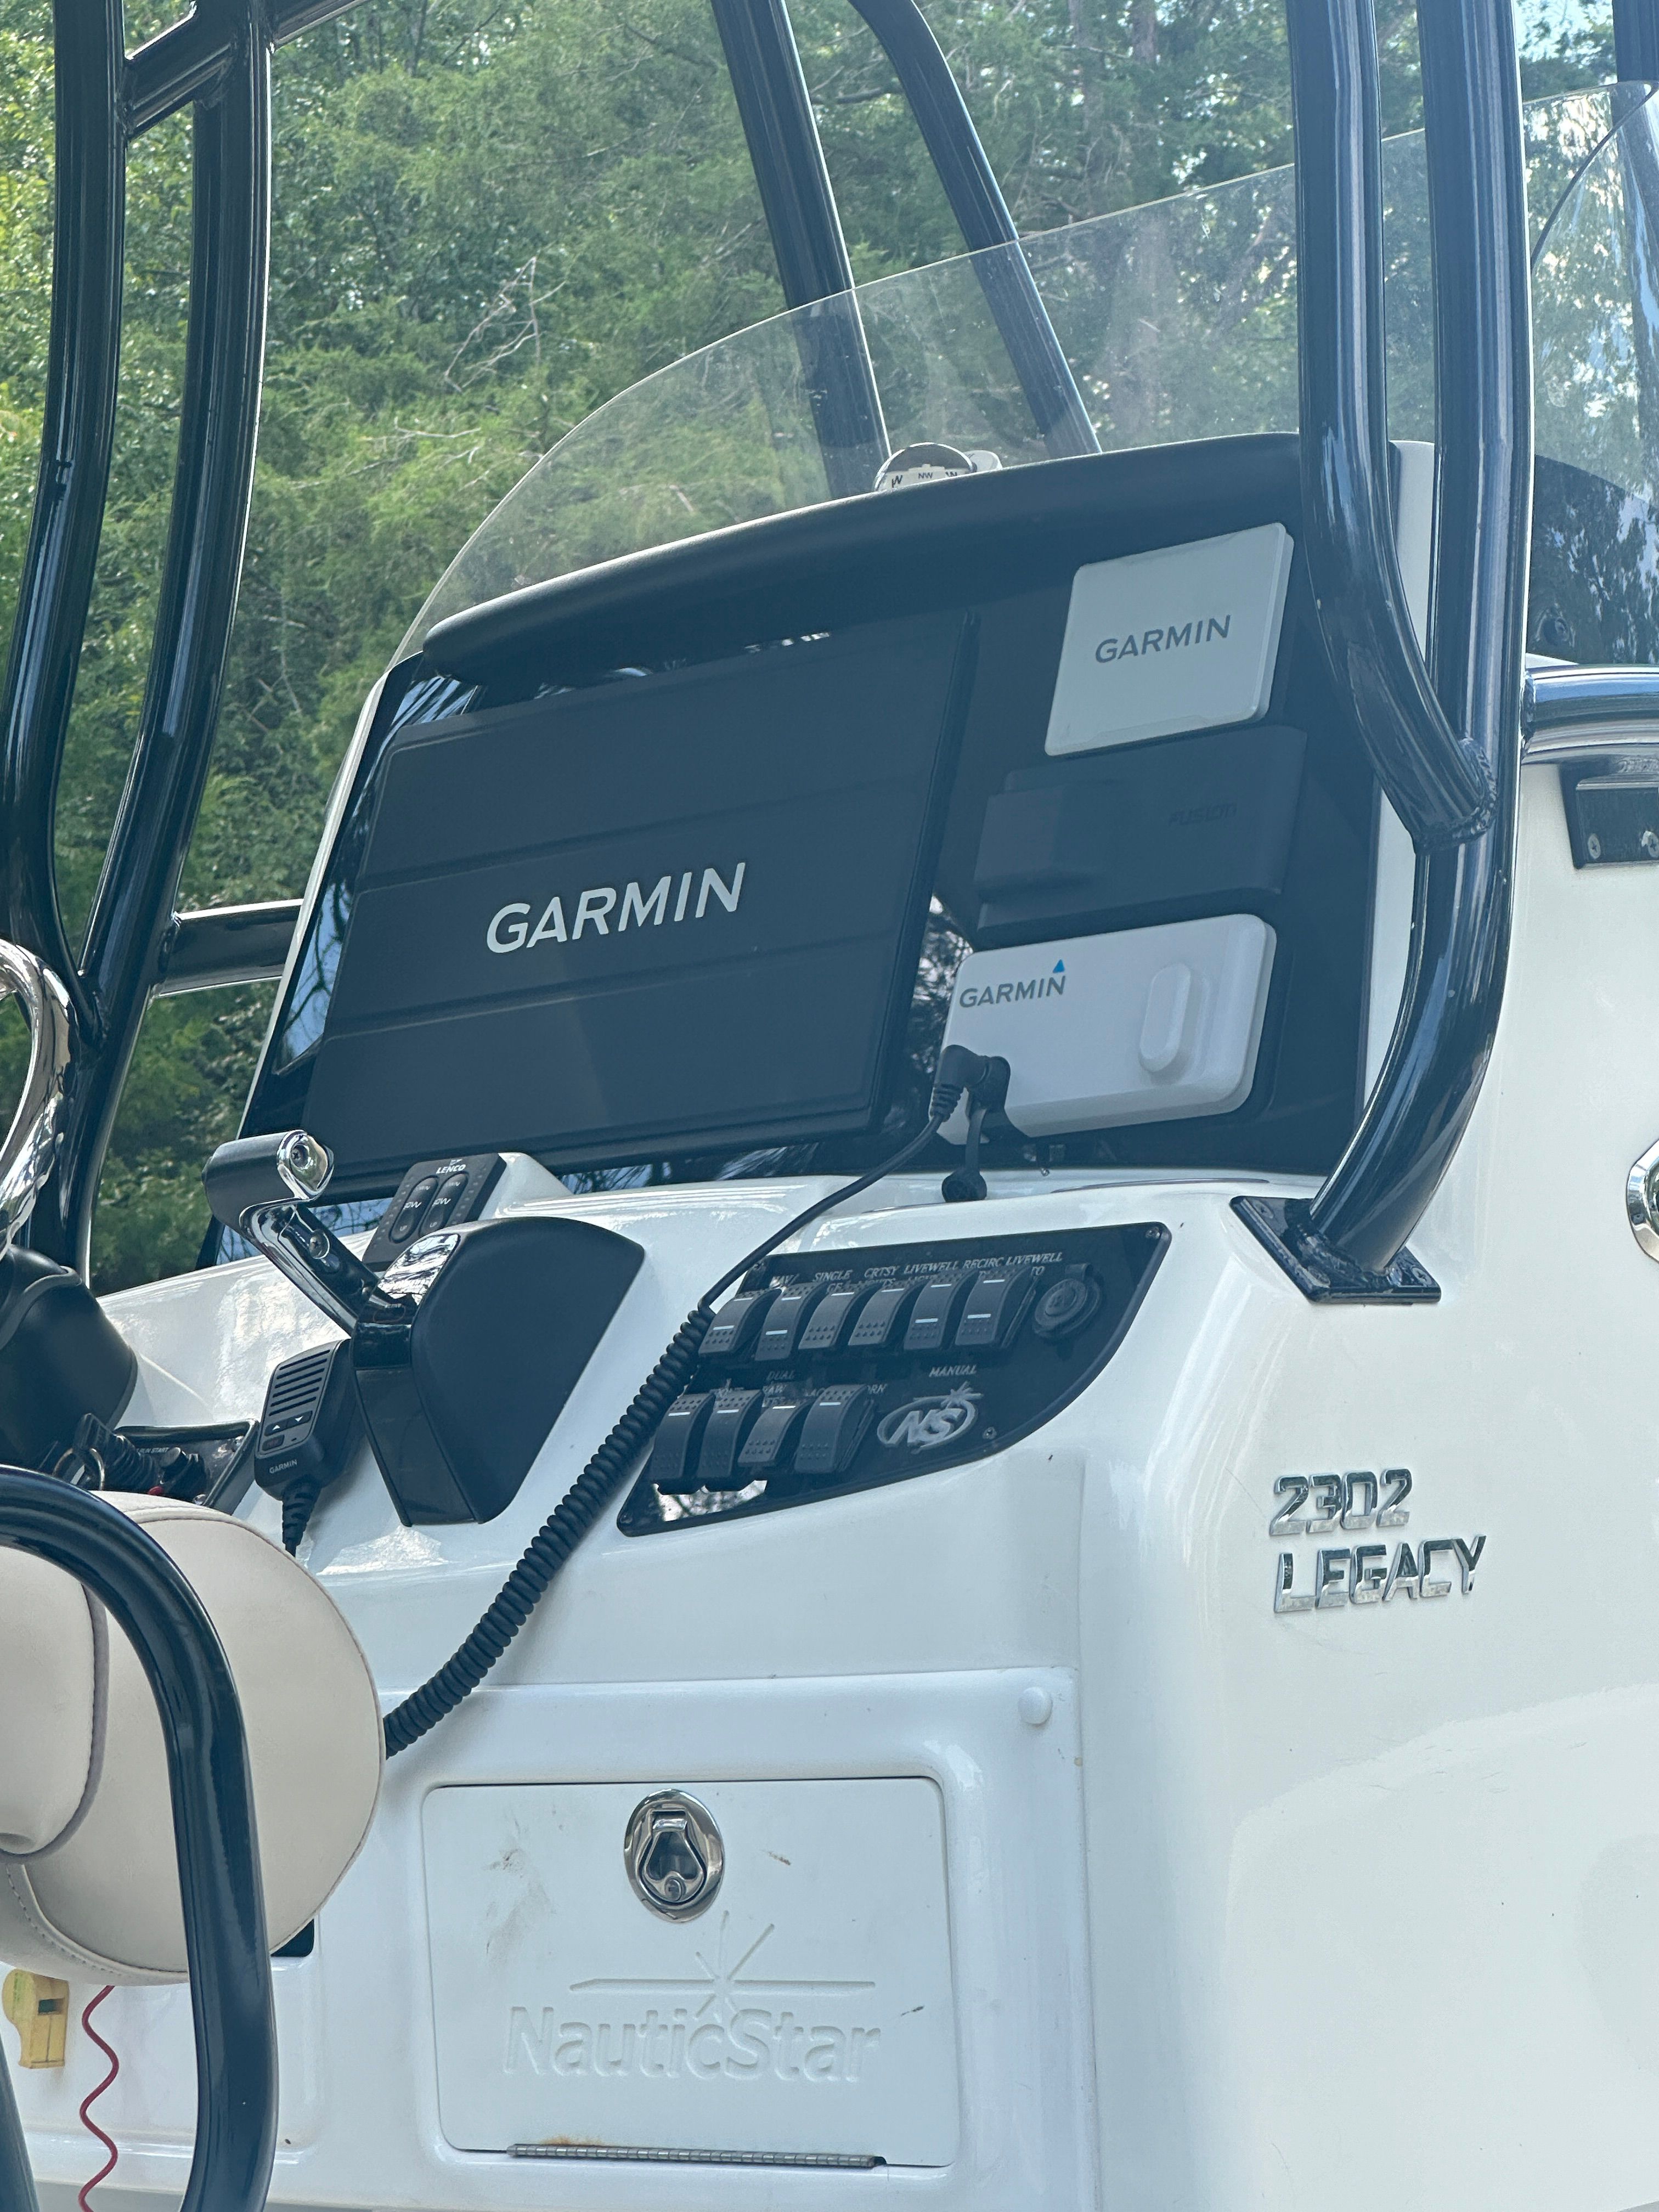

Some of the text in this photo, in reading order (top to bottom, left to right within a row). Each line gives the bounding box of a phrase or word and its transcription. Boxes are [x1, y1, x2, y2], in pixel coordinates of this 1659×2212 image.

[1096, 614, 1231, 663] GARMIN
[487, 862, 746, 953] GARMIN
[960, 975, 1065, 1008] GARMIN
[436, 1164, 466, 1174] LENCO
[962, 1256, 1005, 1269] RECIRC
[1006, 1251, 1063, 1266] LIVEWELL
[864, 1266, 900, 1278] CRTSY
[904, 1261, 960, 1274] LIVEWELL
[814, 1269, 853, 1282] SINGLE
[929, 1364, 978, 1378] MANUAL
[269, 1459, 297, 1474] GARMIN
[1269, 1468, 1413, 1536] 2302
[1274, 1536, 1487, 1613] LEGACY
[503, 2006, 882, 2083] NauticStar
